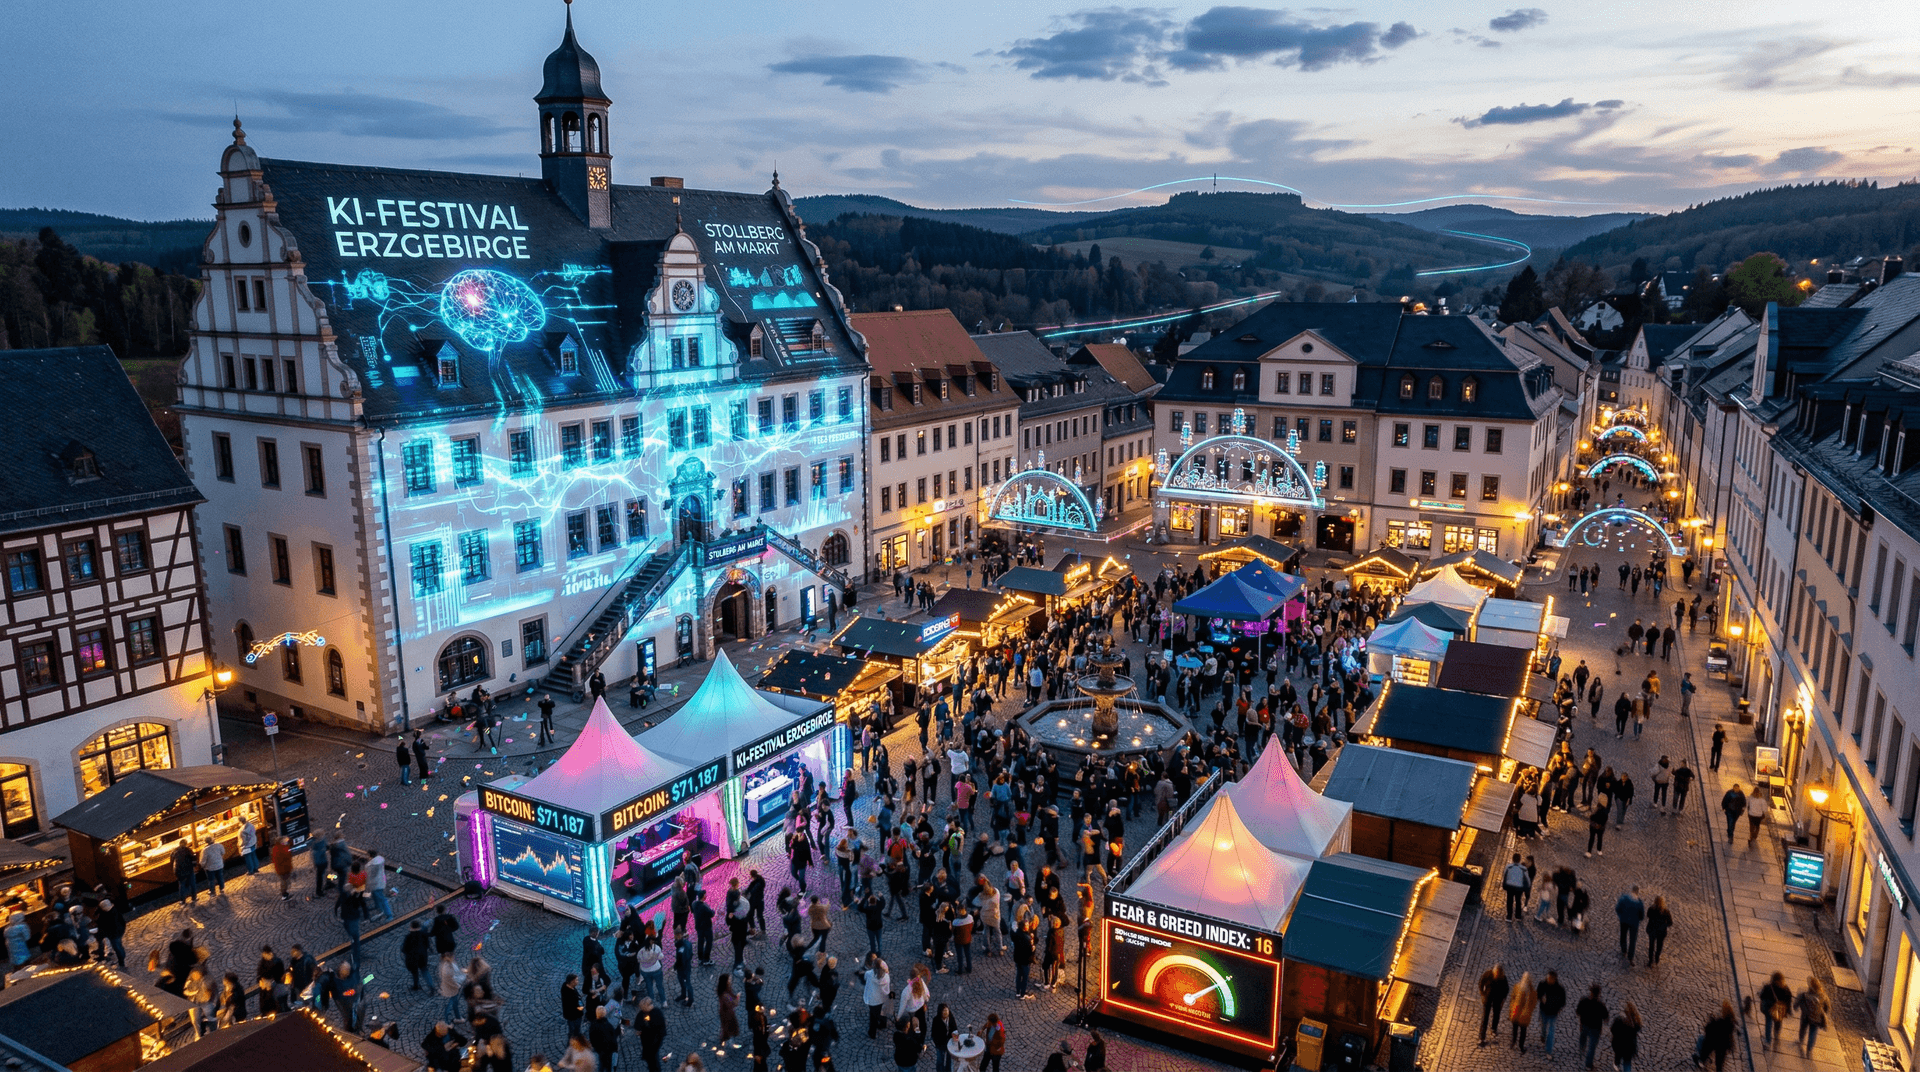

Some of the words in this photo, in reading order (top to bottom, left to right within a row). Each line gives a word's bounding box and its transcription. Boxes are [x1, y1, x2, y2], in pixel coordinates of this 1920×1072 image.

[327, 196, 530, 231] KI-FESTIVAL
[705, 223, 785, 240] STOLLBERG
[335, 231, 531, 259] ERZGEBIRGE
[715, 240, 736, 254] AM
[736, 241, 780, 255] MARKT
[736, 733, 787, 769] KI-FESTIVAL
[786, 709, 833, 745] ERZGEBIRGE
[485, 790, 535, 822] BITCOIN:
[537, 804, 585, 835] $71,187
[613, 790, 670, 831] BITCOIN:
[671, 764, 719, 803] $71,187
[1112, 901, 1145, 924] FEAR
[1147, 910, 1157, 927] &
[1159, 913, 1203, 938] GREED
[1206, 923, 1251, 950] INDEX:
[1255, 936, 1273, 955] 16
